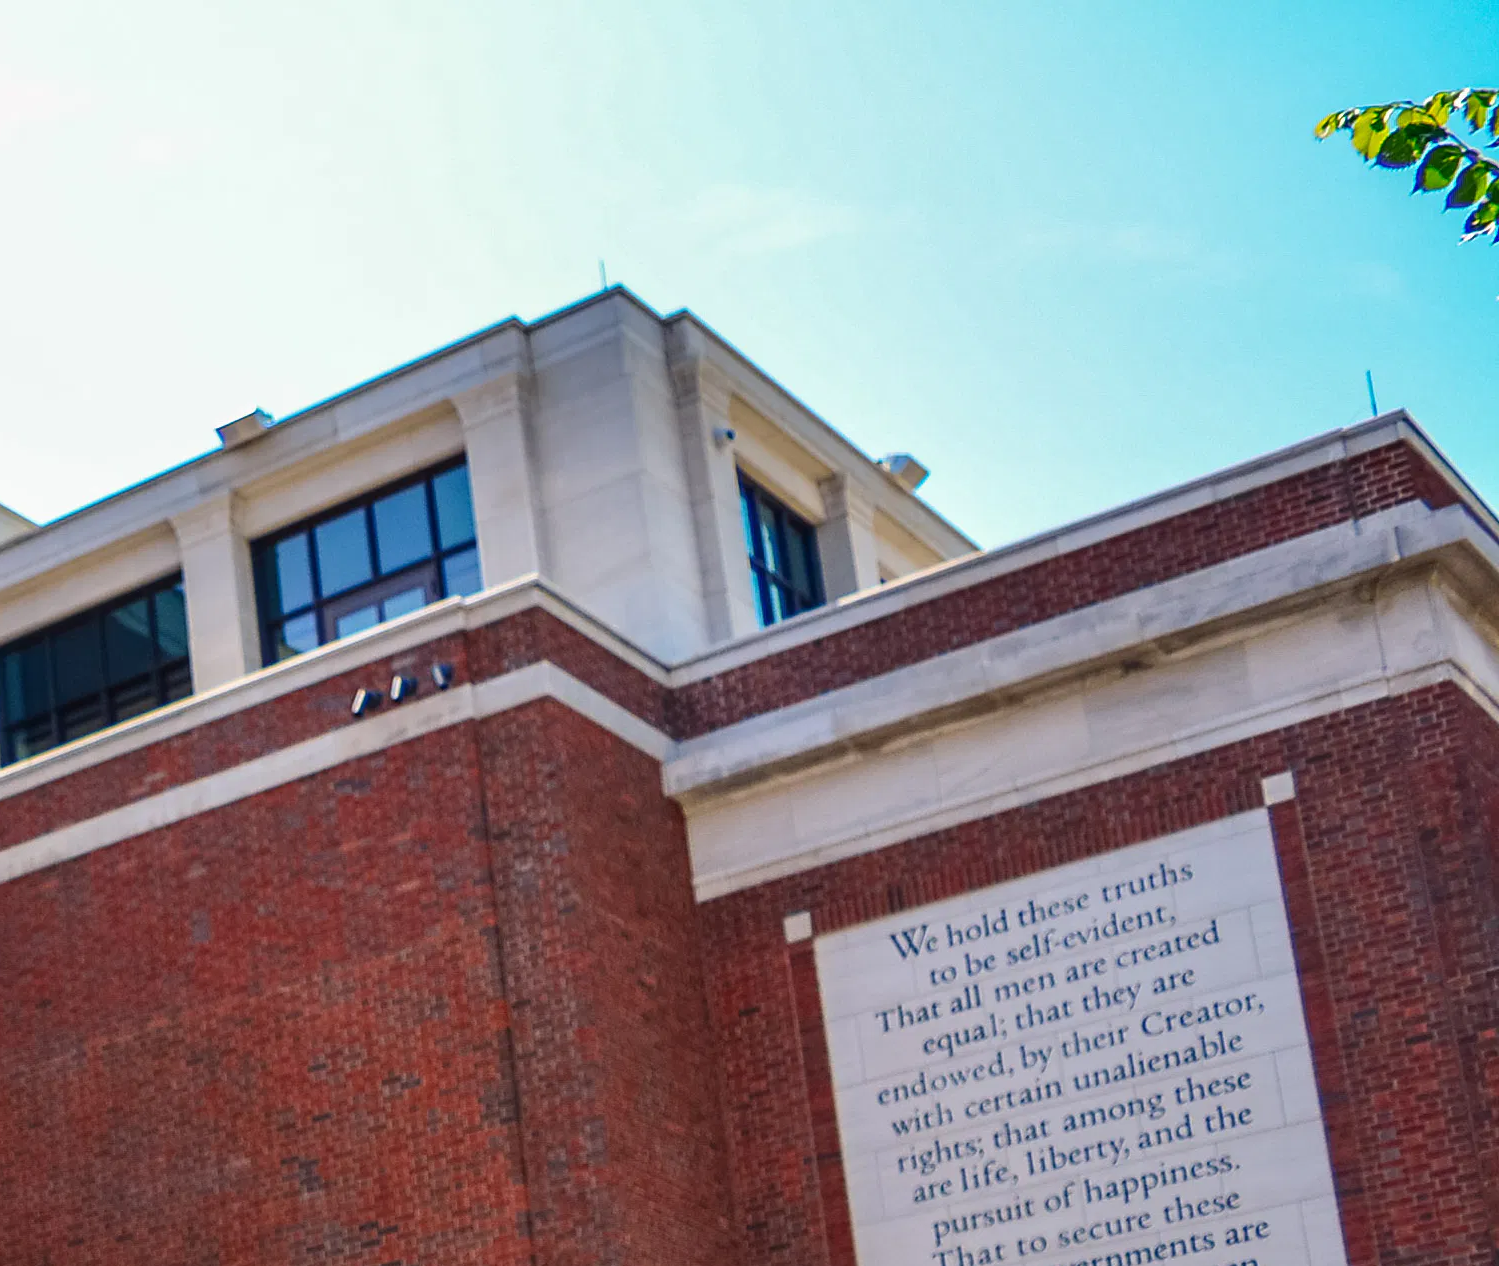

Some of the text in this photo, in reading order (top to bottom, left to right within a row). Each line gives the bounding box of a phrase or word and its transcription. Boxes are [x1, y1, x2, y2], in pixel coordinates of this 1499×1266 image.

[888, 862, 1193, 960] We hold these truths
[928, 905, 1176, 986] to be self-evident,
[874, 917, 1220, 1033] That all men are created
[922, 968, 1195, 1058] equal; that they are
[876, 993, 1264, 1105] endowed, by their Creator,
[891, 1029, 1243, 1136] with certain unalienable
[896, 1071, 1251, 1176] rights; that among these
[913, 1103, 1253, 1204] are life, liberty, and the
[932, 1154, 1240, 1248] pursuit of happiness.
[1016, 1235, 1047, 1257] to
[1057, 1212, 1151, 1248] secure
[1162, 1191, 1240, 1224] these
[1224, 1220, 1269, 1246] are
